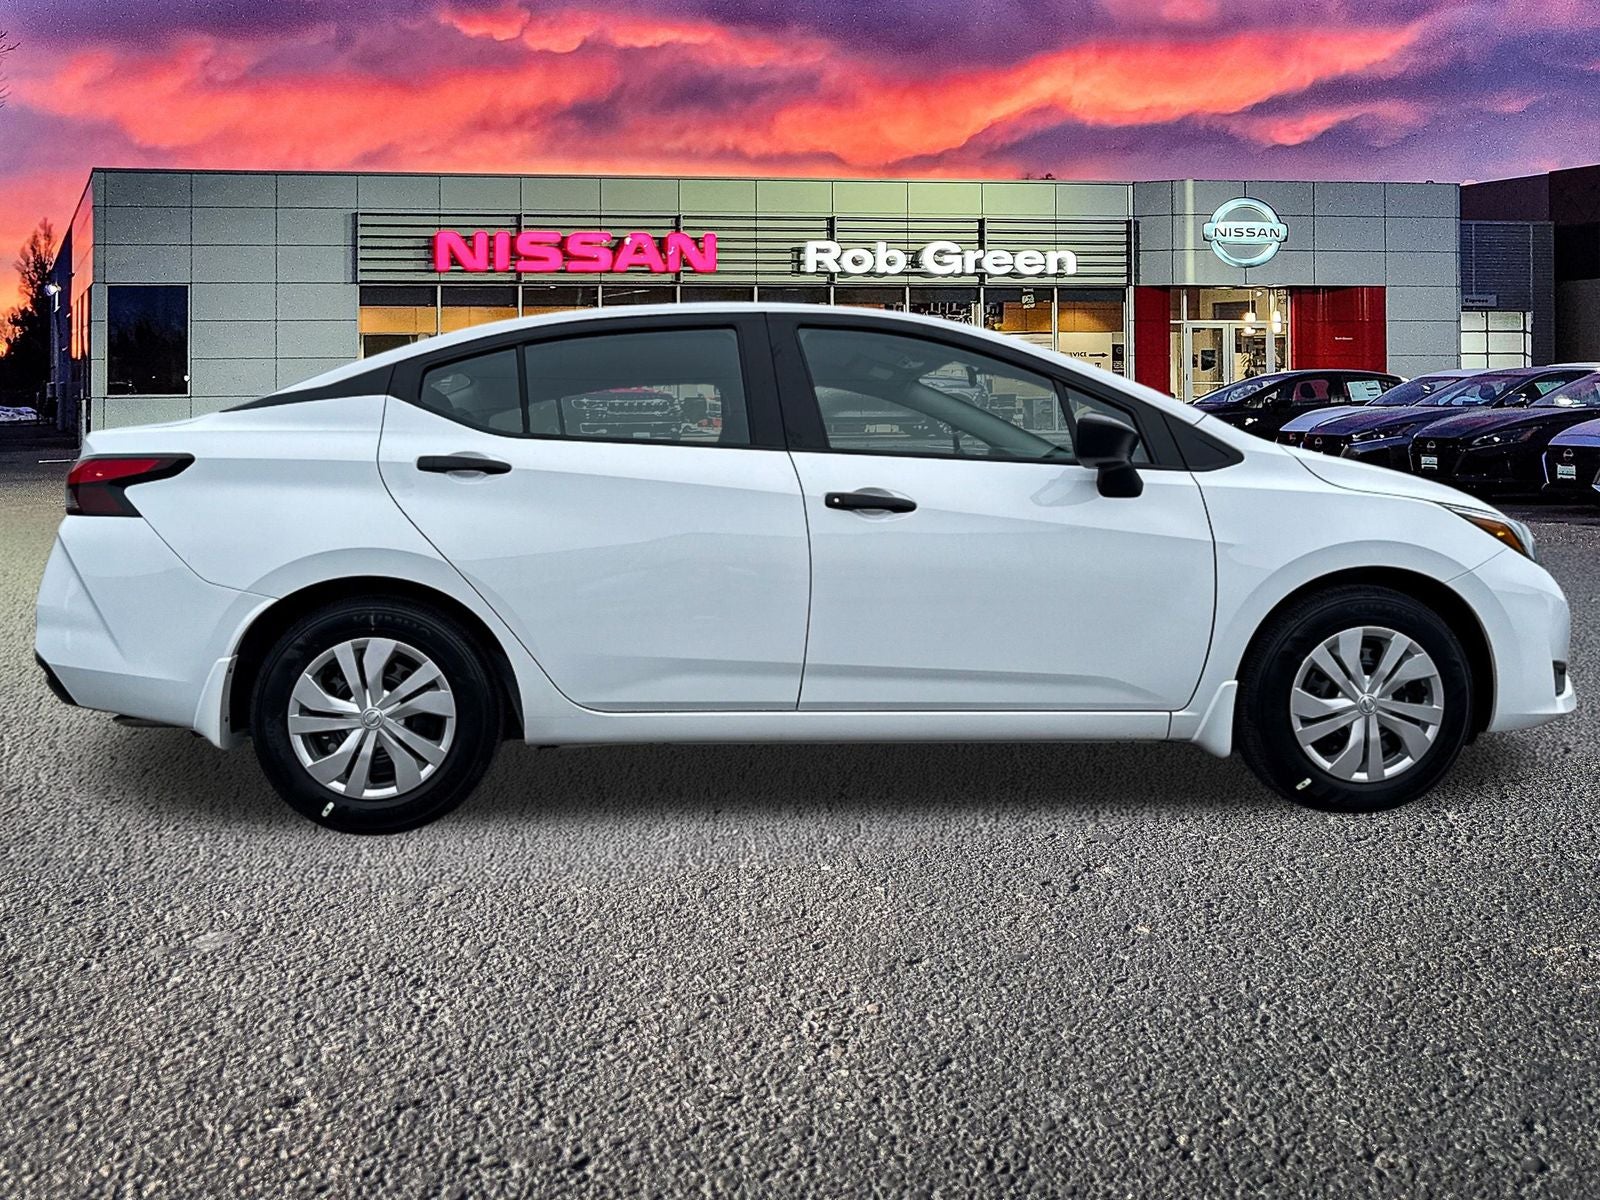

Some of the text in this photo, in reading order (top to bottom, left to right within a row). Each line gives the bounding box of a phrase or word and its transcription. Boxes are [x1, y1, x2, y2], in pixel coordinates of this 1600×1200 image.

[1214, 227, 1280, 238] NISSAN
[434, 230, 718, 273] NISSAN
[804, 240, 1078, 275] Rob Green
